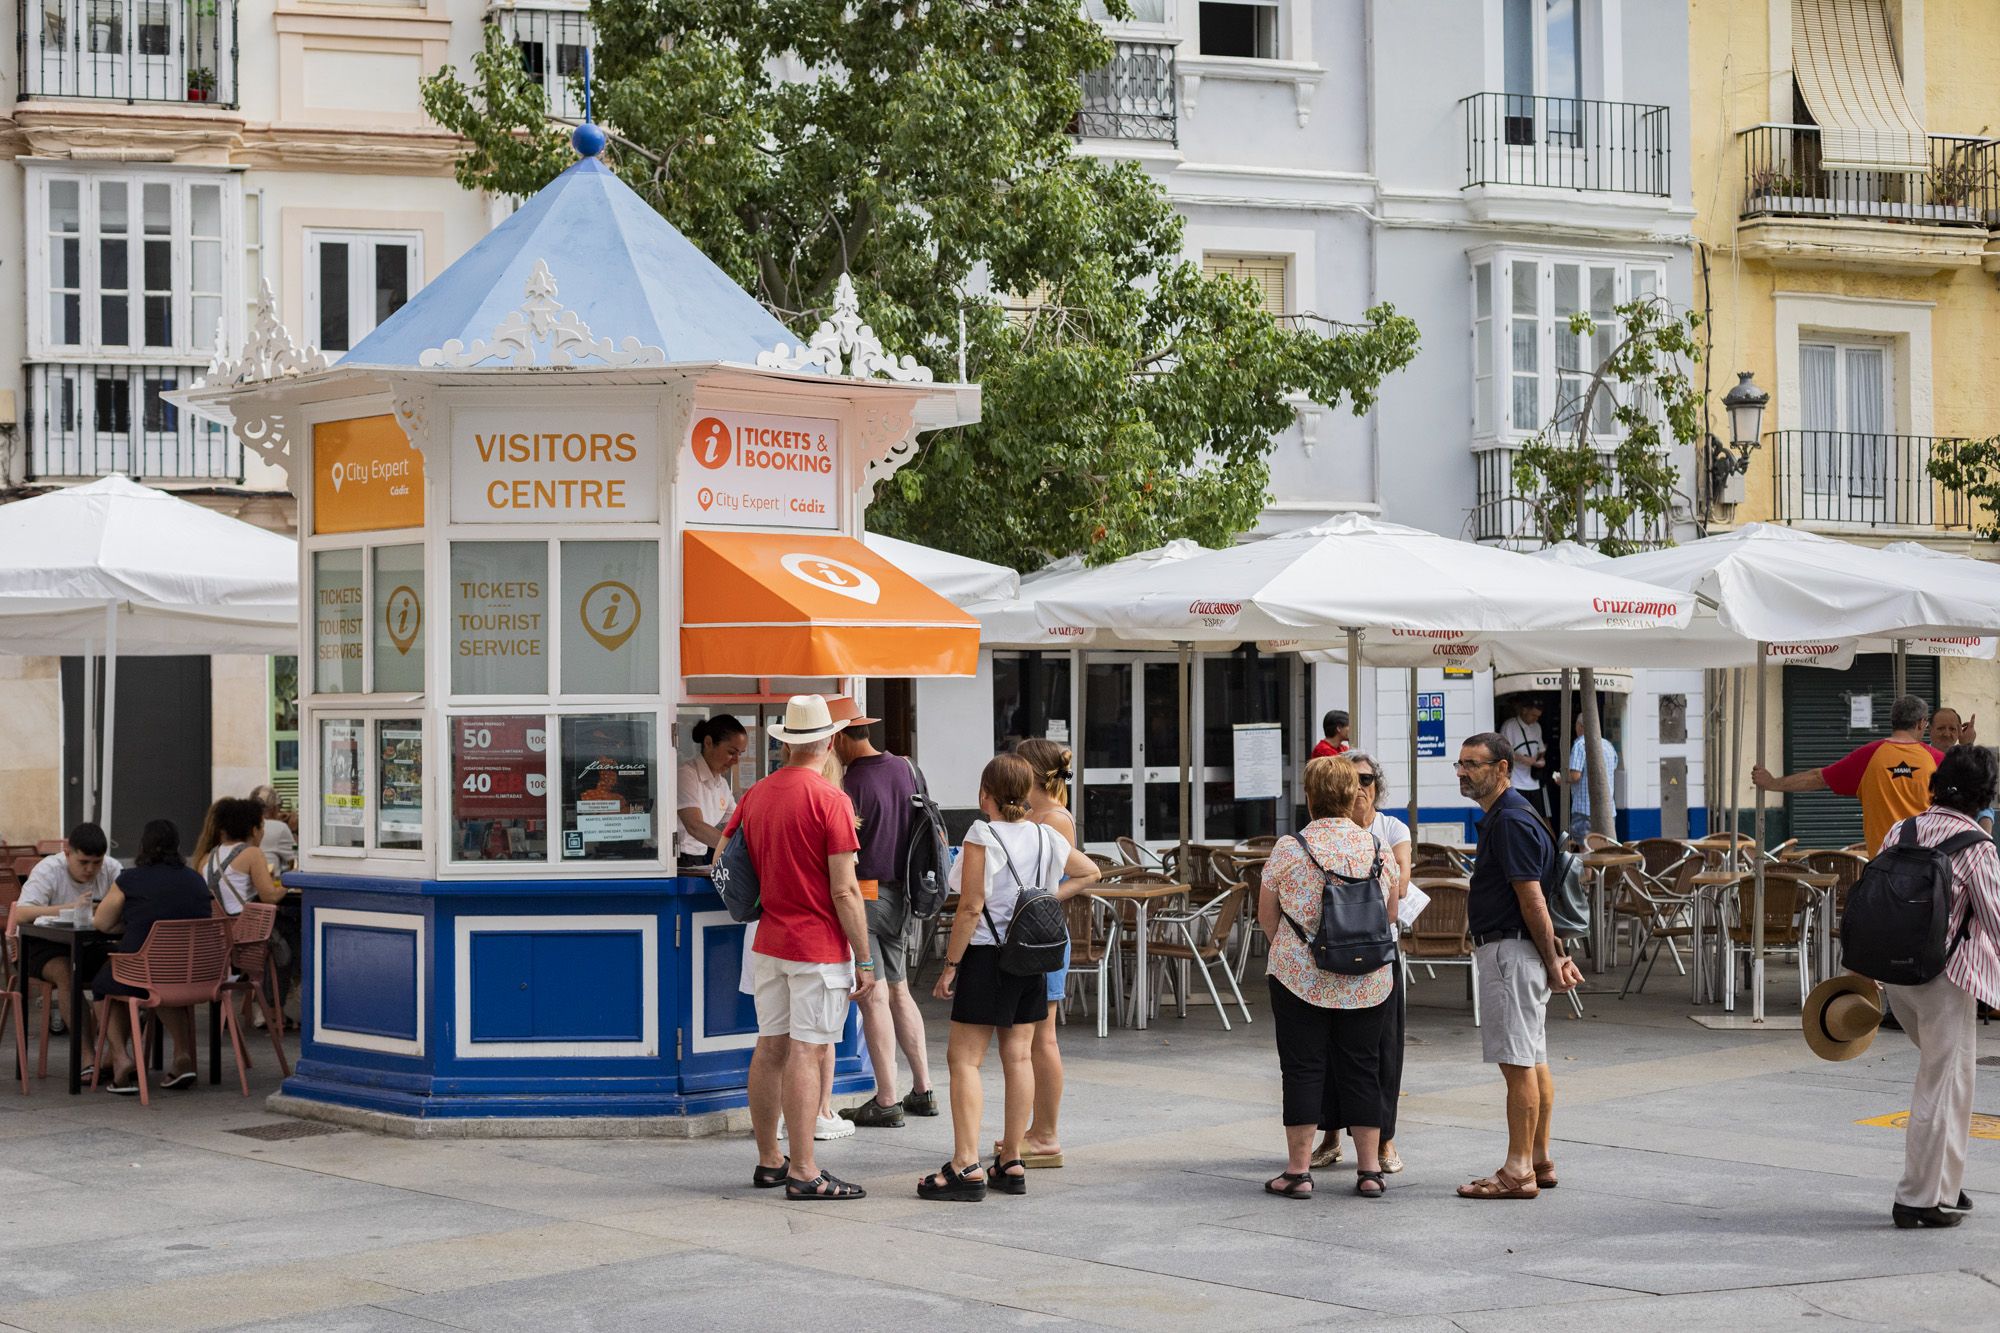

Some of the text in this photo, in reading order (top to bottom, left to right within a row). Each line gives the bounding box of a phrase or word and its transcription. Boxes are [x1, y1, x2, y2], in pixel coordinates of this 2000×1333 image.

[474, 433, 637, 463] VISITORS
[744, 427, 828, 452] TICKETS &
[346, 459, 409, 484] City Expert
[745, 450, 832, 474] BOOKING
[486, 479, 626, 509] CENTRE
[716, 491, 825, 514] City Expert Cádiz
[319, 587, 362, 605] TICKETS
[460, 582, 539, 599] TICKETS
[1592, 597, 1677, 618] Cruzcampo
[319, 618, 363, 635] TOURIST
[458, 614, 541, 631] TOURIST
[319, 642, 363, 660] SERVICE
[459, 639, 541, 657] SERVICE
[1766, 641, 1840, 656] Cruzcampo
[463, 729, 492, 748] 50
[577, 760, 647, 780] flamenco
[462, 773, 492, 793] 40
